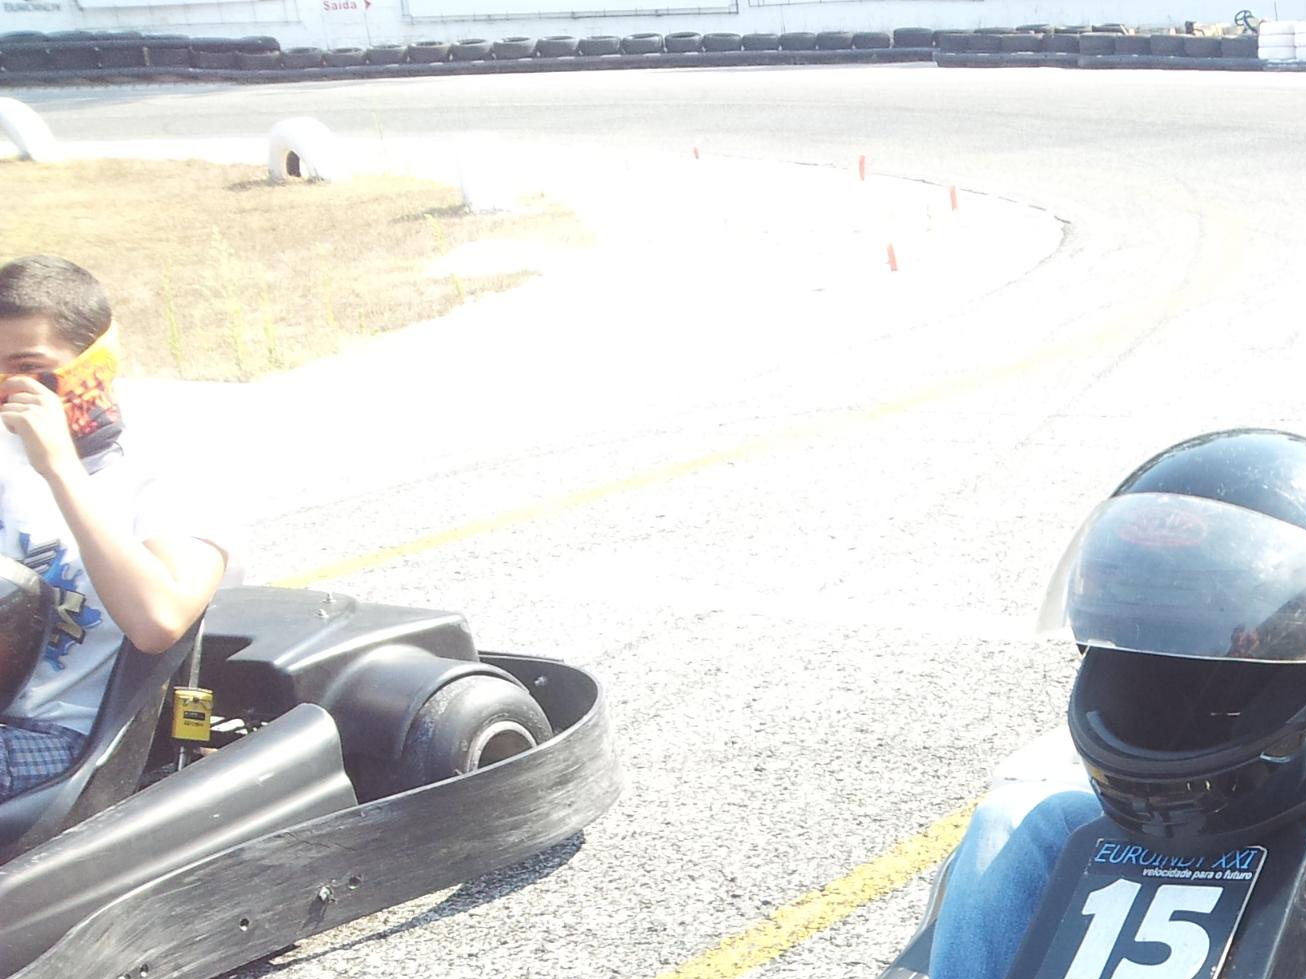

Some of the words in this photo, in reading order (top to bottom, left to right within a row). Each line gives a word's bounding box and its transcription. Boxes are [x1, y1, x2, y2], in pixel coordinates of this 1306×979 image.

[1211, 849, 1258, 869] XXI
[1143, 867, 1191, 878] velocidade
[1191, 871, 1214, 880] para
[1223, 869, 1253, 880] futuro
